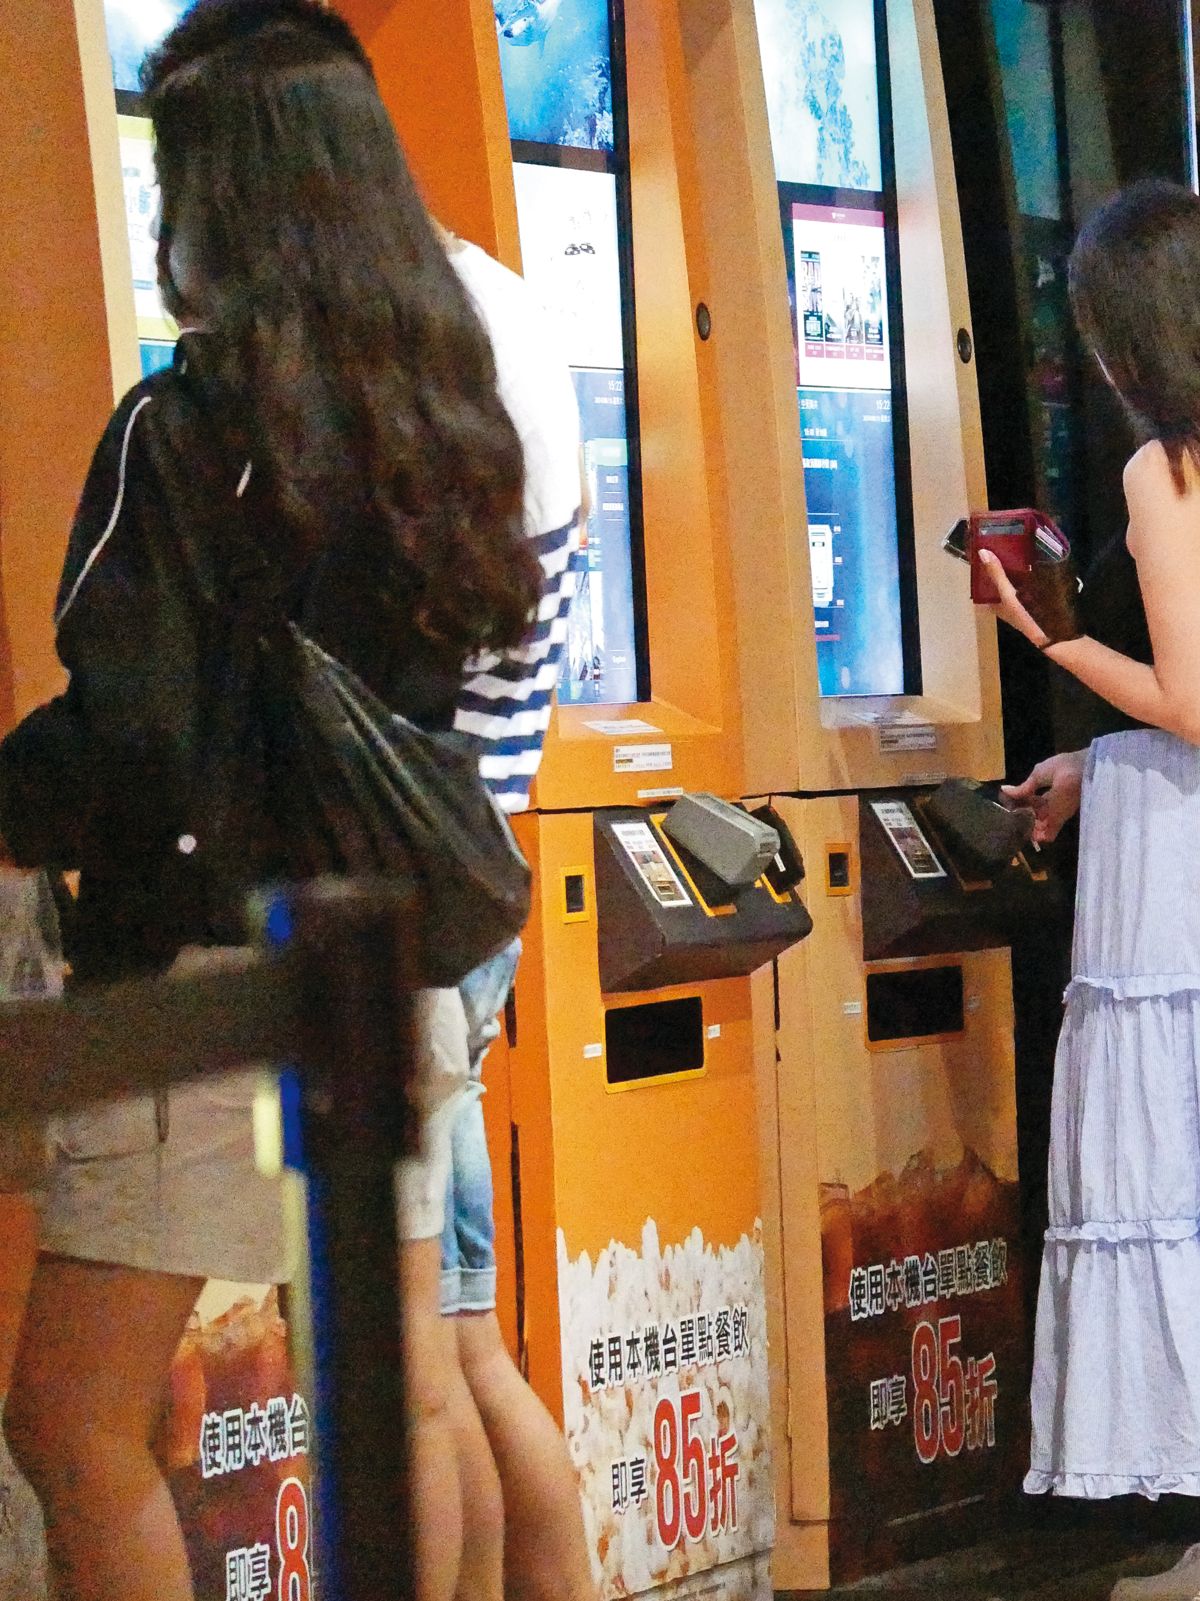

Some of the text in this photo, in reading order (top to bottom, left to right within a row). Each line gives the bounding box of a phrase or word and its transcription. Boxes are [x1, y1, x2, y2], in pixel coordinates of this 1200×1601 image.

[849, 1237, 1009, 1321] 使用本機台單點餐飲
[587, 1304, 750, 1389] 使用本機台單點餐飲
[200, 1393, 310, 1479] 使用本機台
